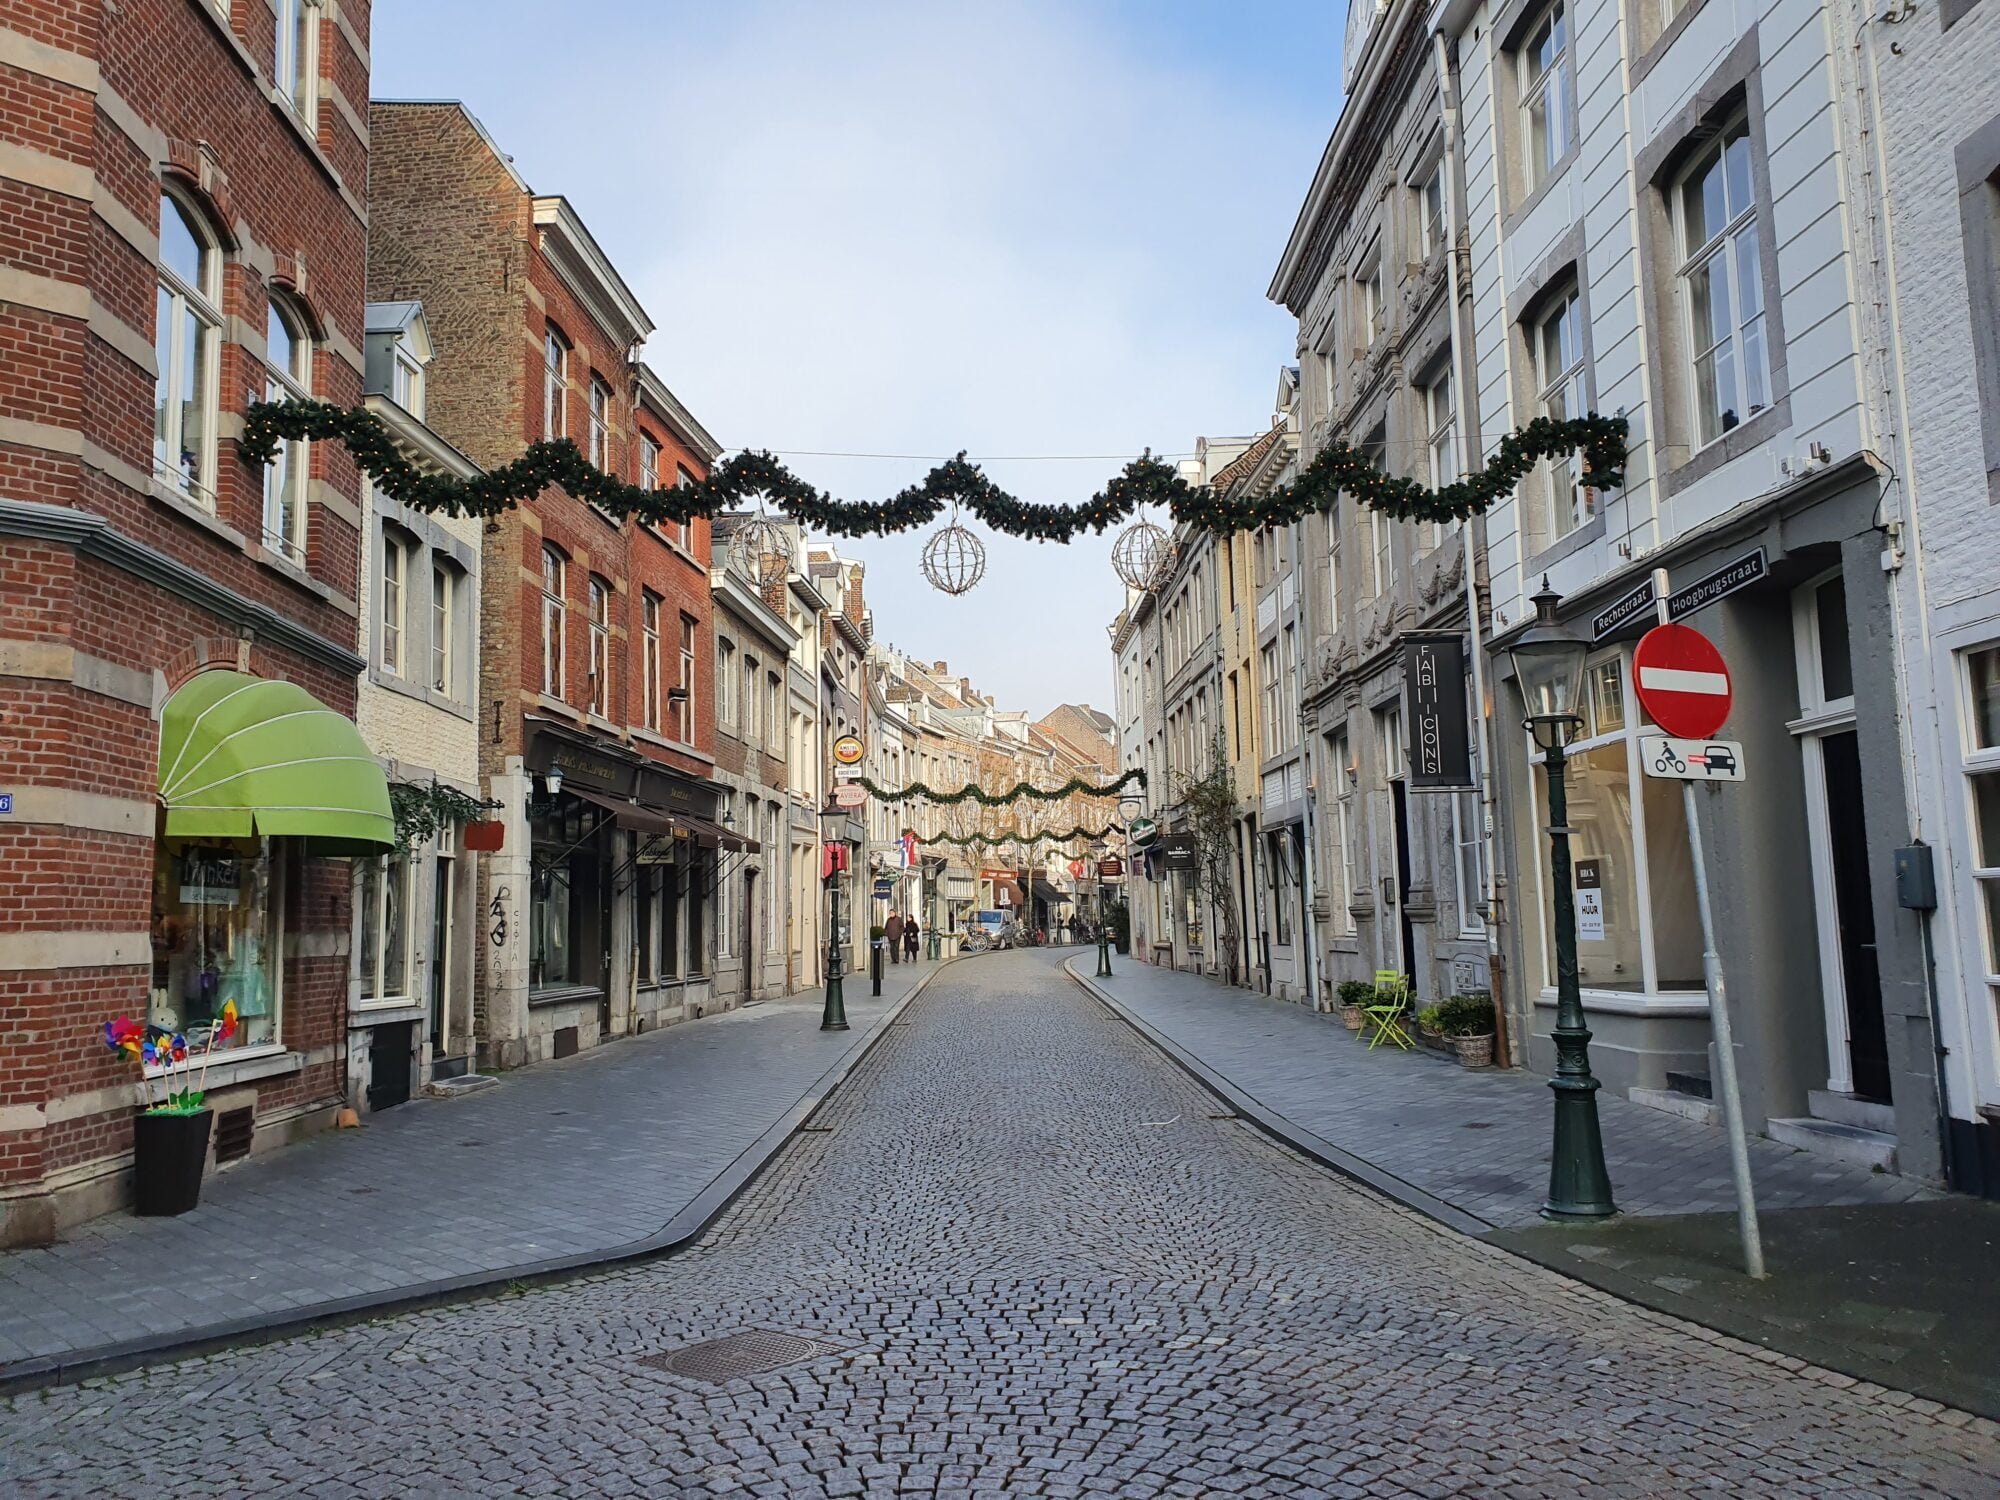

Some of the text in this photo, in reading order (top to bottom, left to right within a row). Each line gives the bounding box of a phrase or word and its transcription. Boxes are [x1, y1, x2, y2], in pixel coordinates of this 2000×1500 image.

[1671, 558, 1758, 614] Hoogbrugstraat
[1597, 590, 1648, 631] Rechtstraat
[1420, 645, 1432, 686] FAB
[1423, 703, 1437, 774] ICONS
[1581, 905, 1599, 915] HUUR
[1585, 894, 1593, 904] TE
